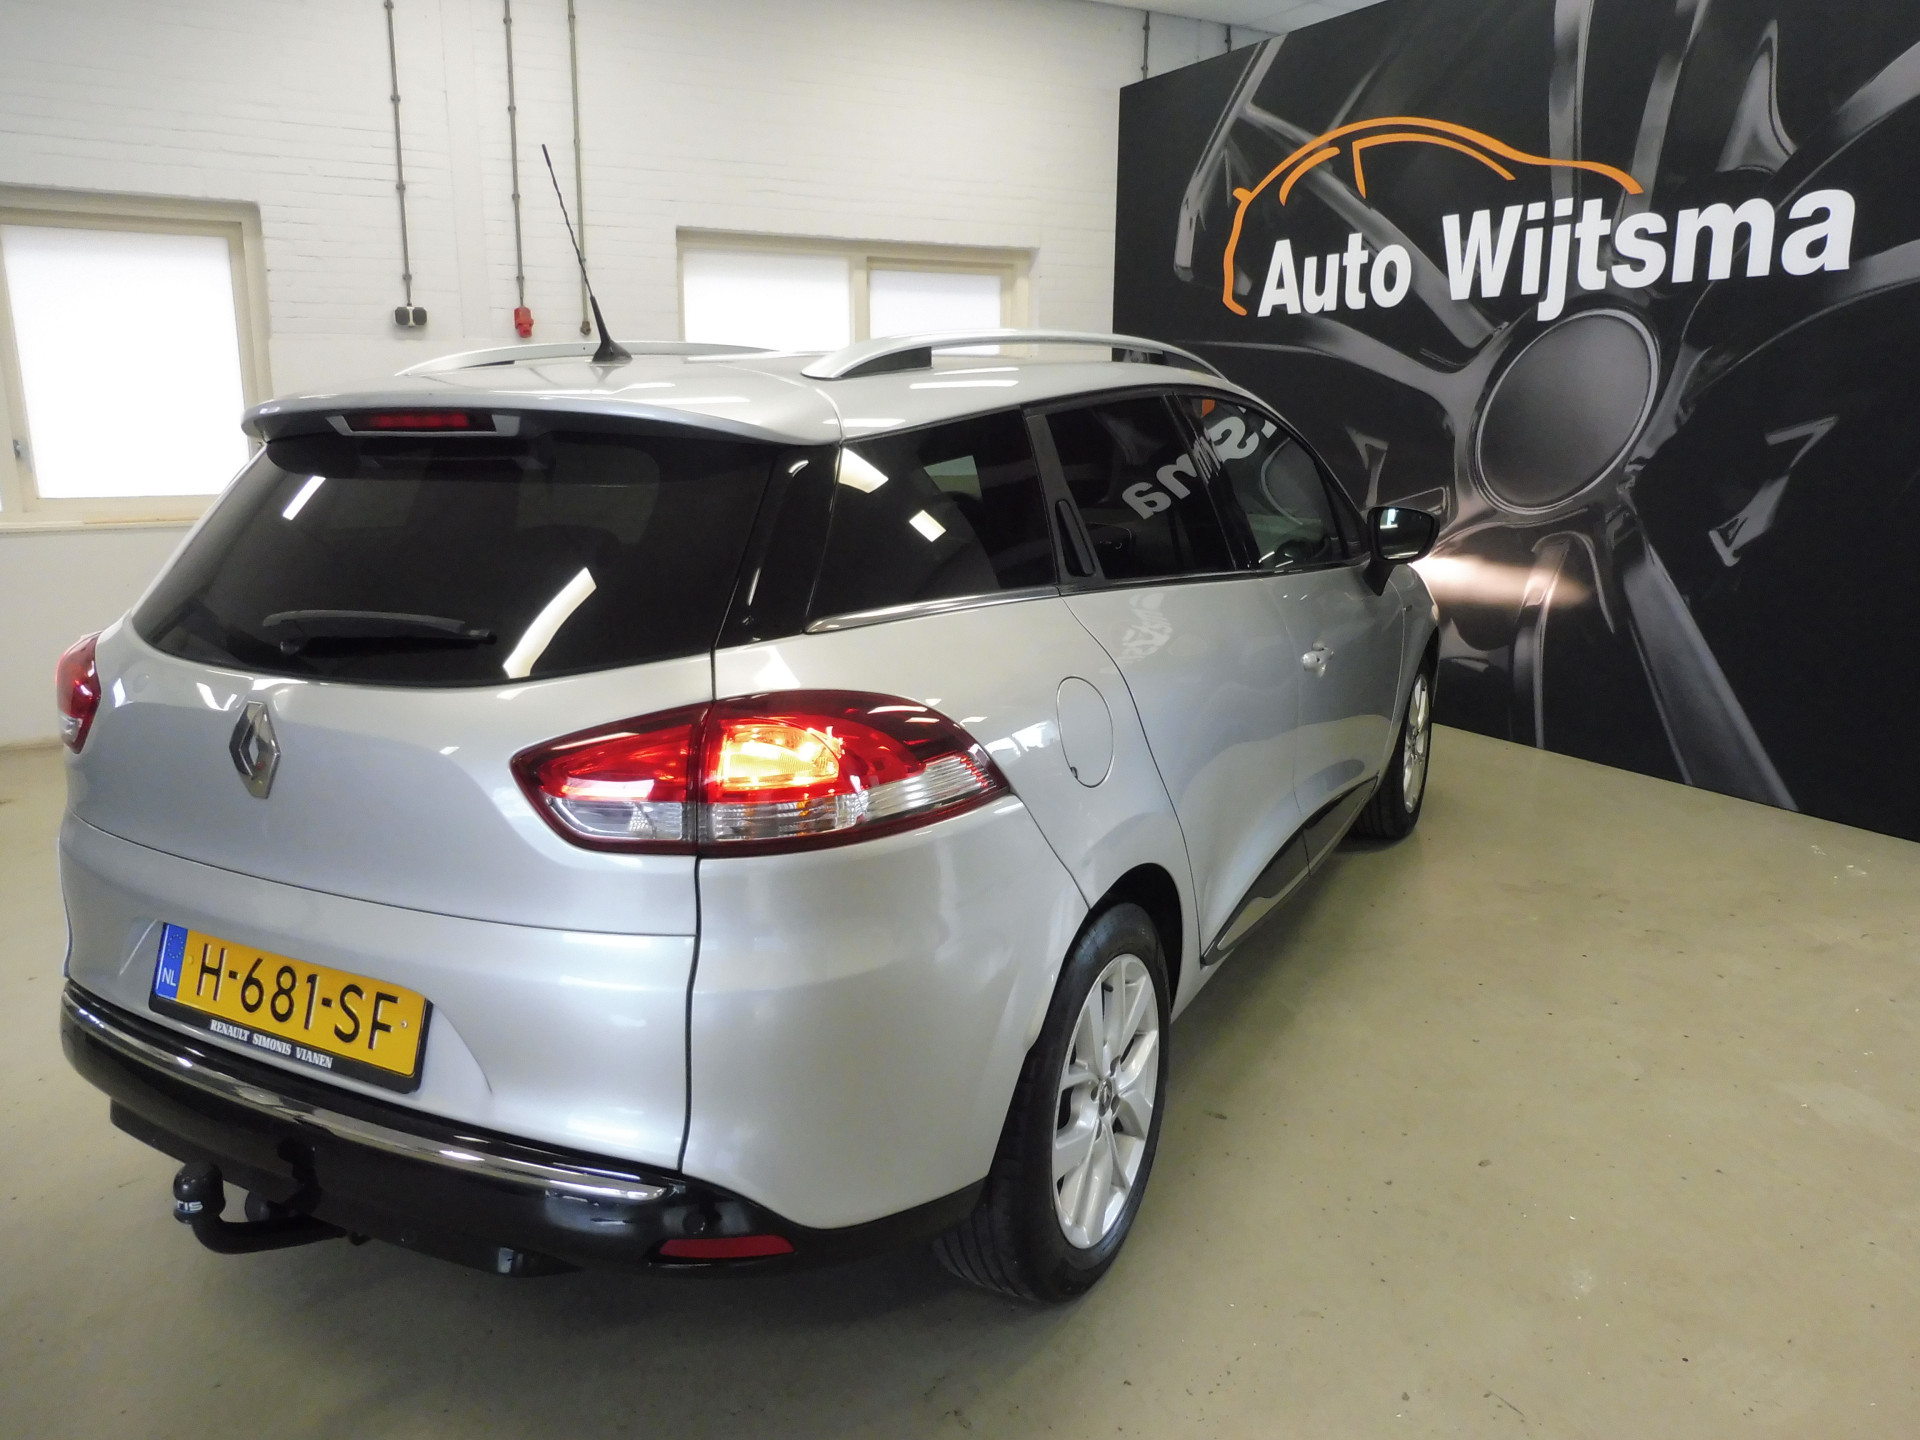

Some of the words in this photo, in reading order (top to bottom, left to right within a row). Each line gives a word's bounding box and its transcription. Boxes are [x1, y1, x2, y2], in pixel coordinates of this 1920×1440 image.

[1257, 232, 1412, 318] Auto
[1442, 189, 1856, 322] Wijtsma
[161, 967, 177, 987] NL
[196, 943, 400, 1051] H-681-SF
[210, 1019, 250, 1042] RENAULT
[252, 1033, 292, 1056] SIMONIS
[295, 1047, 334, 1069] VIANEN
